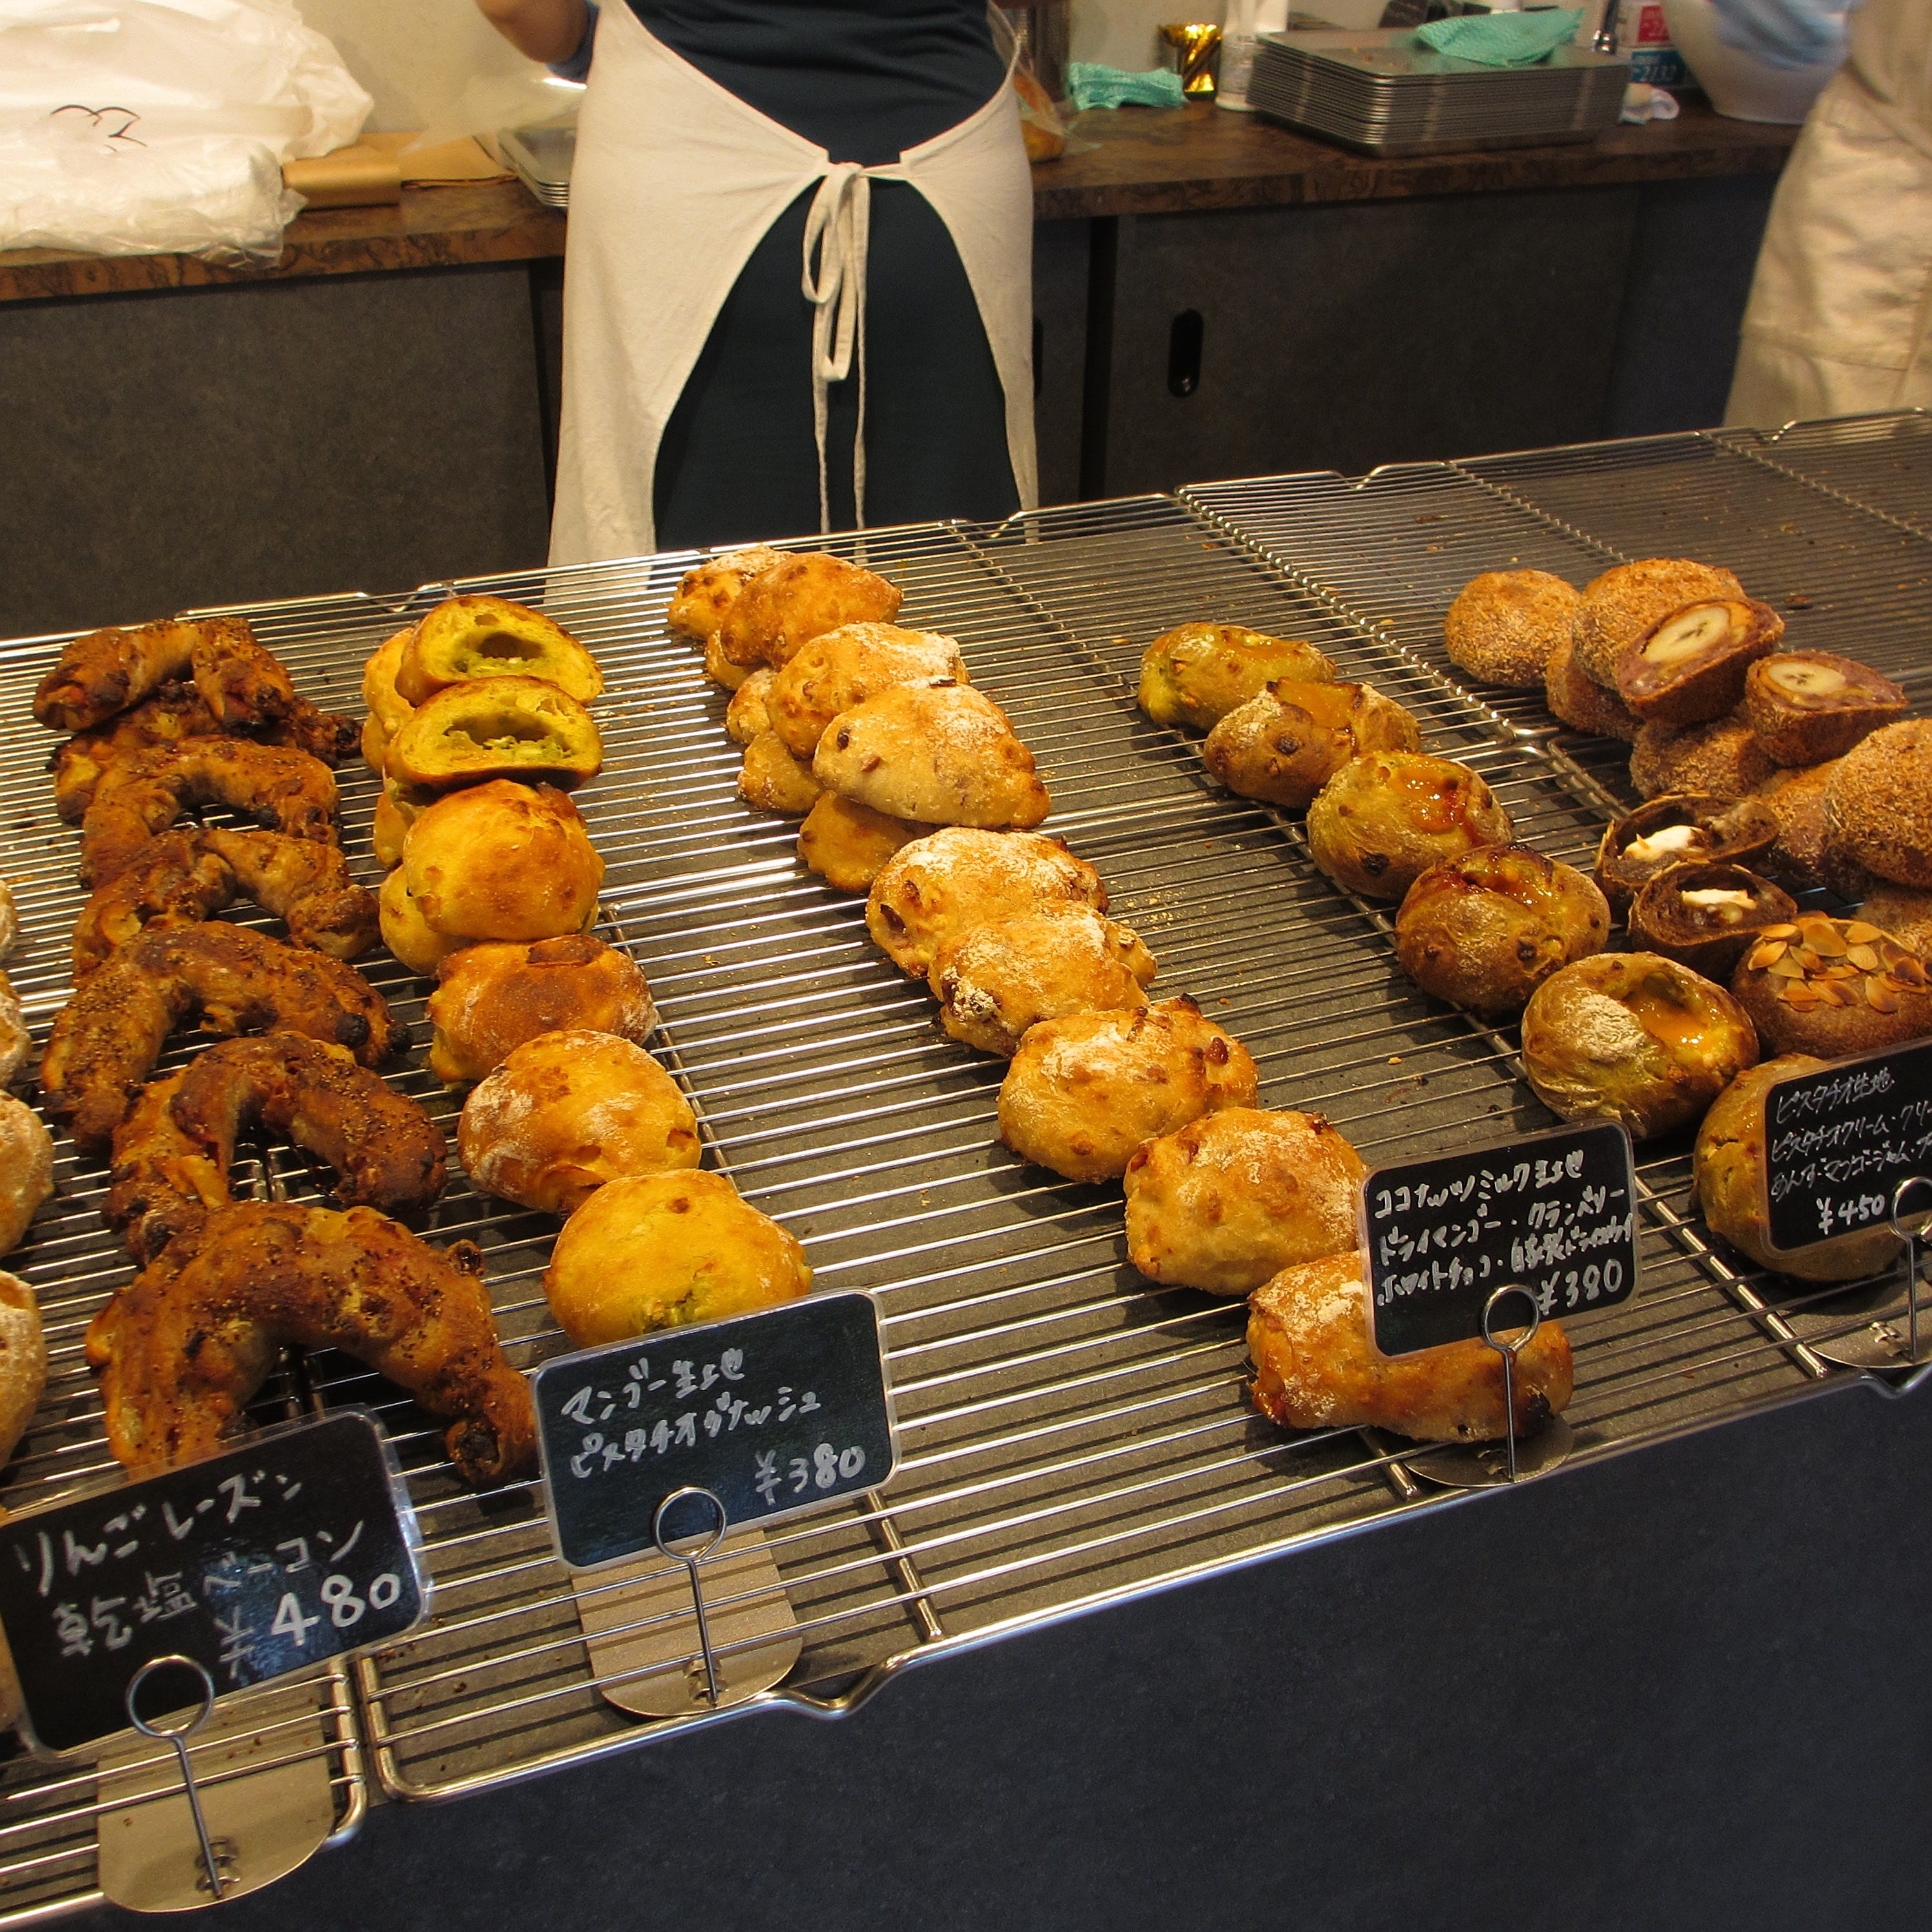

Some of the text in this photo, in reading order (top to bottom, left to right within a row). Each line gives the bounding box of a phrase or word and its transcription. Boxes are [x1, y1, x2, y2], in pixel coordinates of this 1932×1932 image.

[1375, 1149, 1584, 1219] ココナッツミルク生地
[1816, 1195, 1886, 1235] ¥450
[1536, 1259, 1623, 1315] ¥380
[561, 1348, 745, 1424] マンゴー生地
[570, 1386, 821, 1478] ピスタチオガナッシュ
[754, 1443, 866, 1505] ¥380
[214, 1572, 401, 1680] ¥480
